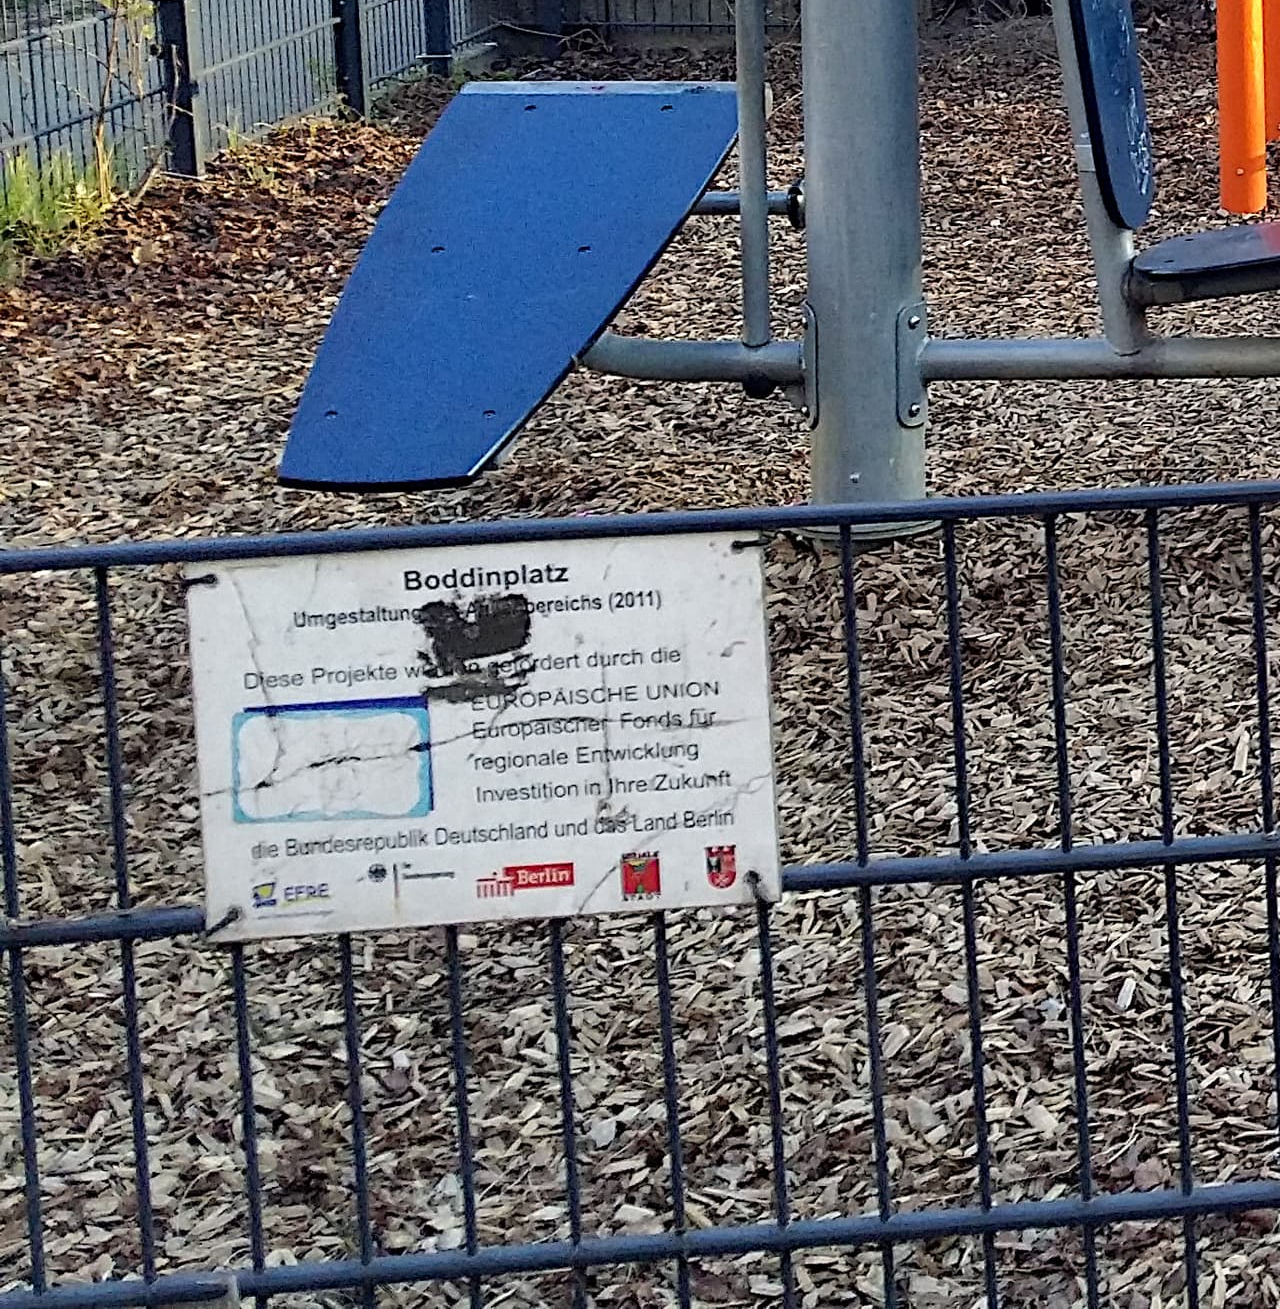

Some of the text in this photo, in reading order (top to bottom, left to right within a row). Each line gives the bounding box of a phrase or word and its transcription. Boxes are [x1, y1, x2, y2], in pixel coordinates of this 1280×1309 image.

[404, 564, 569, 590] Boddinplatz
[293, 605, 424, 630] Umgestaltung
[608, 590, 662, 613] (2011)
[243, 671, 304, 690] Diese
[311, 664, 398, 688] Projekte
[587, 650, 643, 669] durch
[650, 647, 681, 664] die
[646, 681, 719, 700] UNION
[620, 711, 682, 729] Fonds
[474, 741, 699, 773] regionale Entwicklung
[476, 770, 731, 803] Investition in Ihre Zukunft
[251, 841, 279, 860] die
[286, 831, 429, 858] Bundesrepublik
[435, 821, 548, 846] Deutschland
[554, 818, 588, 837] und
[632, 812, 677, 832] Land
[683, 810, 734, 828] Berlin
[517, 866, 570, 886] Berlin
